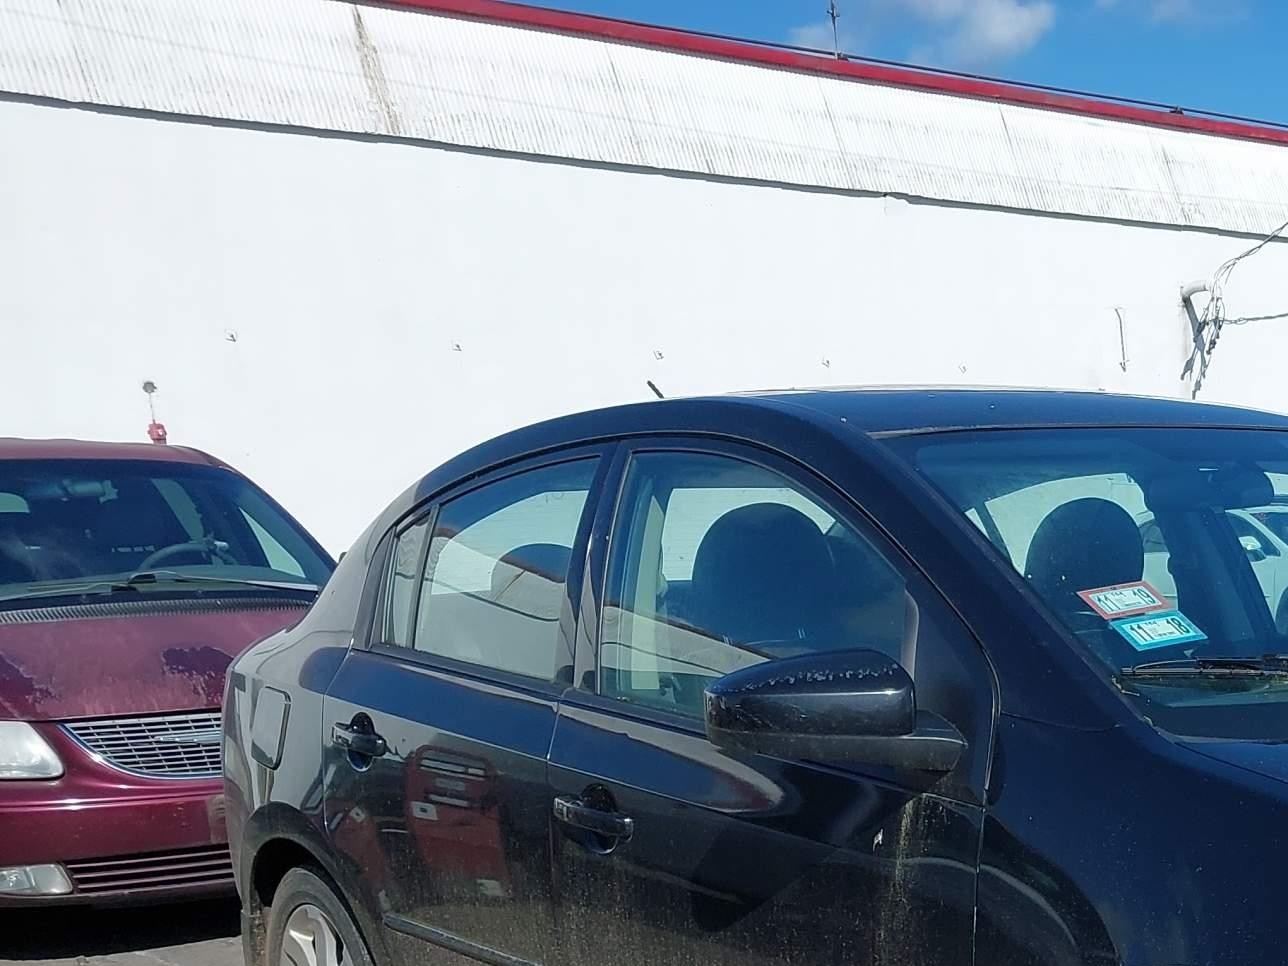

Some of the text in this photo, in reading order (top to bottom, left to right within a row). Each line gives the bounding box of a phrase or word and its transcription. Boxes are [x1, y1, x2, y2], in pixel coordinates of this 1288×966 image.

[1132, 588, 1156, 605] 19
[1129, 617, 1190, 642] 11 18
